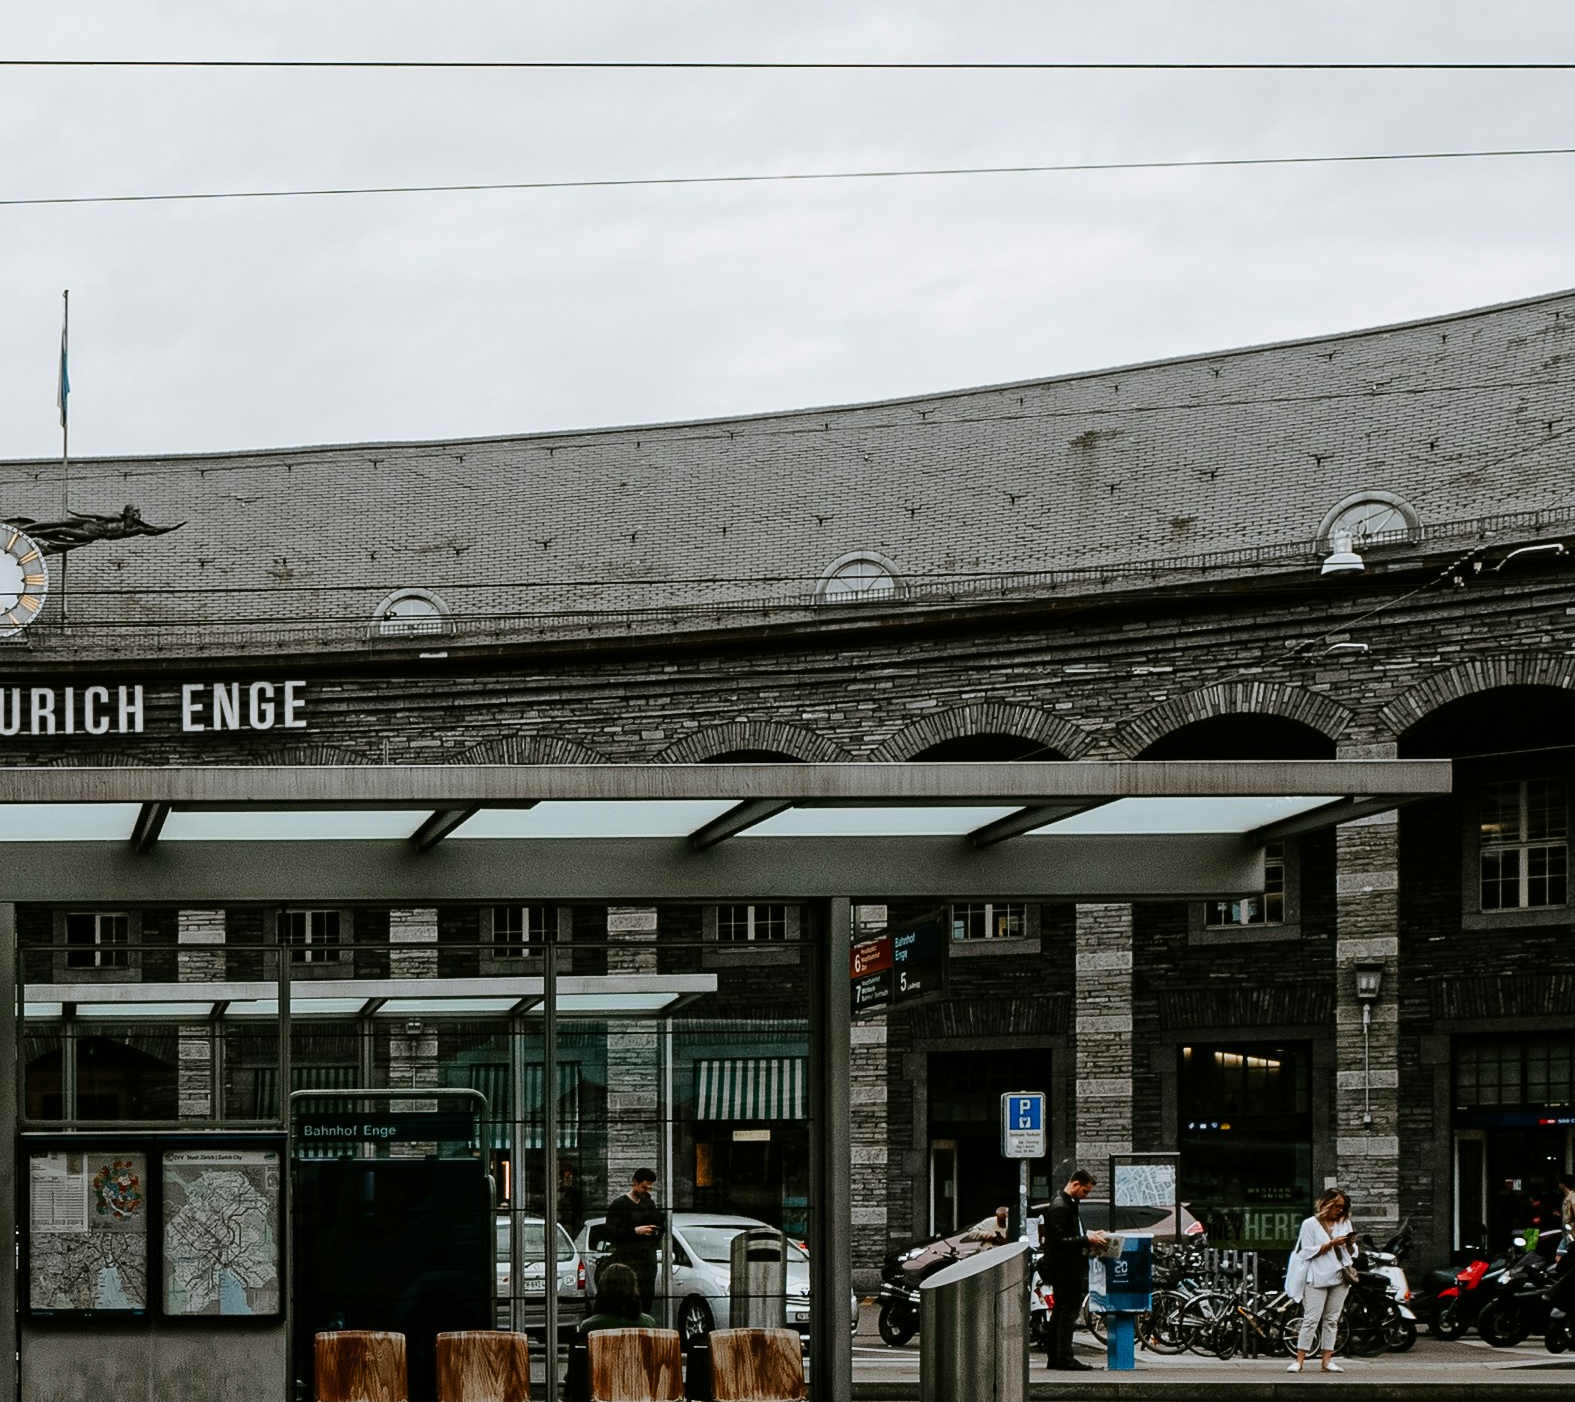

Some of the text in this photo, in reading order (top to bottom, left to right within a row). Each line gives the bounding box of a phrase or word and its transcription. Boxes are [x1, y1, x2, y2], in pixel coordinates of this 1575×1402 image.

[182, 680, 307, 732] ENGE
[895, 932, 916, 948] Bahnhof
[854, 954, 861, 973] 6
[895, 950, 908, 962] Enge
[900, 972, 907, 992] 5
[856, 985, 862, 1003] 7
[1019, 1099, 1031, 1115] P
[304, 1125, 396, 1137] Bahnhof Enge
[1244, 1212, 1303, 1241] HERE
[1114, 1260, 1128, 1274] 20
